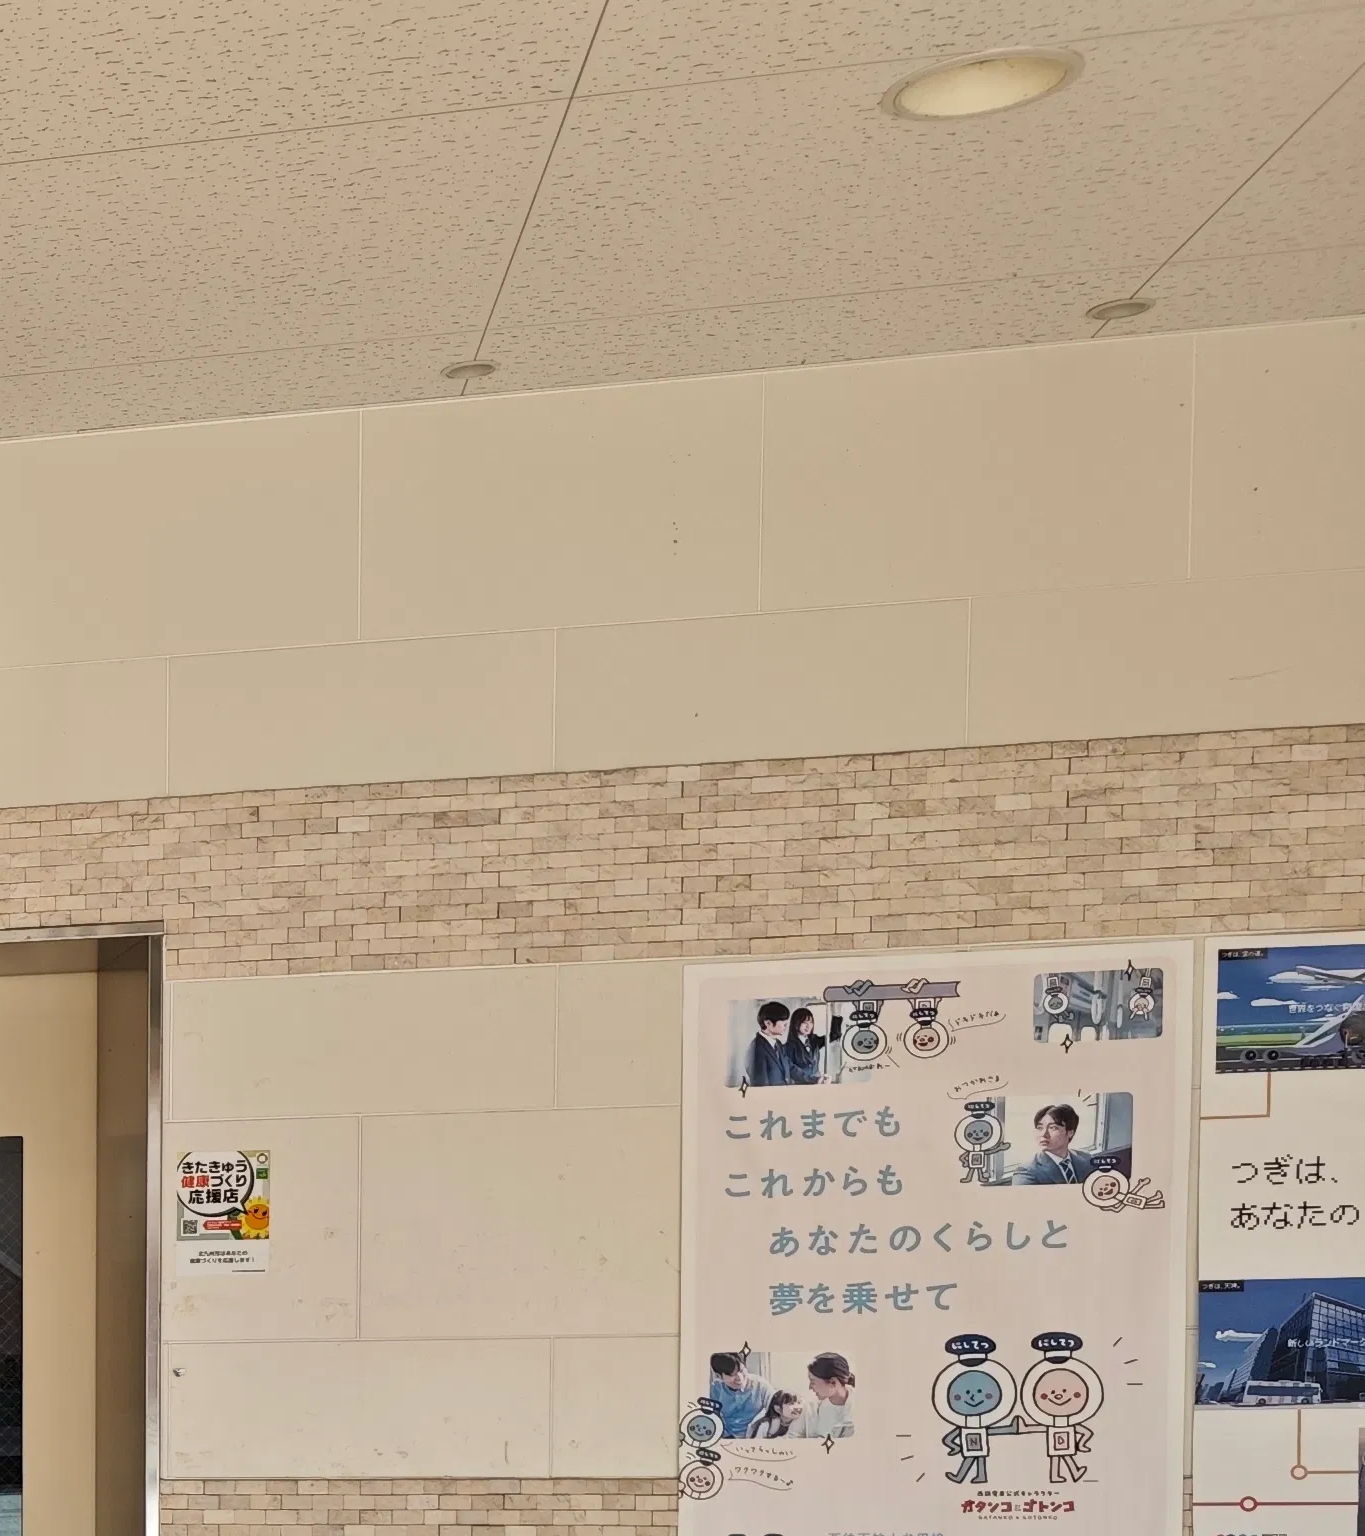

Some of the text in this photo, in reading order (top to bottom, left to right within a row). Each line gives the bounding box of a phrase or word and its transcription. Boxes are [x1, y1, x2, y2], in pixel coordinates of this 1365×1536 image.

[725, 1105, 901, 1140] これまでも
[181, 1174, 247, 1188] 健康づくり
[182, 1160, 247, 1174] きたきゅう
[725, 1164, 903, 1199] これからも
[1232, 1154, 1338, 1185] つぎは、
[188, 1188, 239, 1204] 応援店
[1231, 1201, 1359, 1230] あなたの
[769, 1219, 1068, 1257] あなたのくらしと
[769, 1281, 957, 1317] 夢を乗せて
[951, 1341, 989, 1350] にしてつ
[1038, 1339, 1075, 1348] にしてつ
